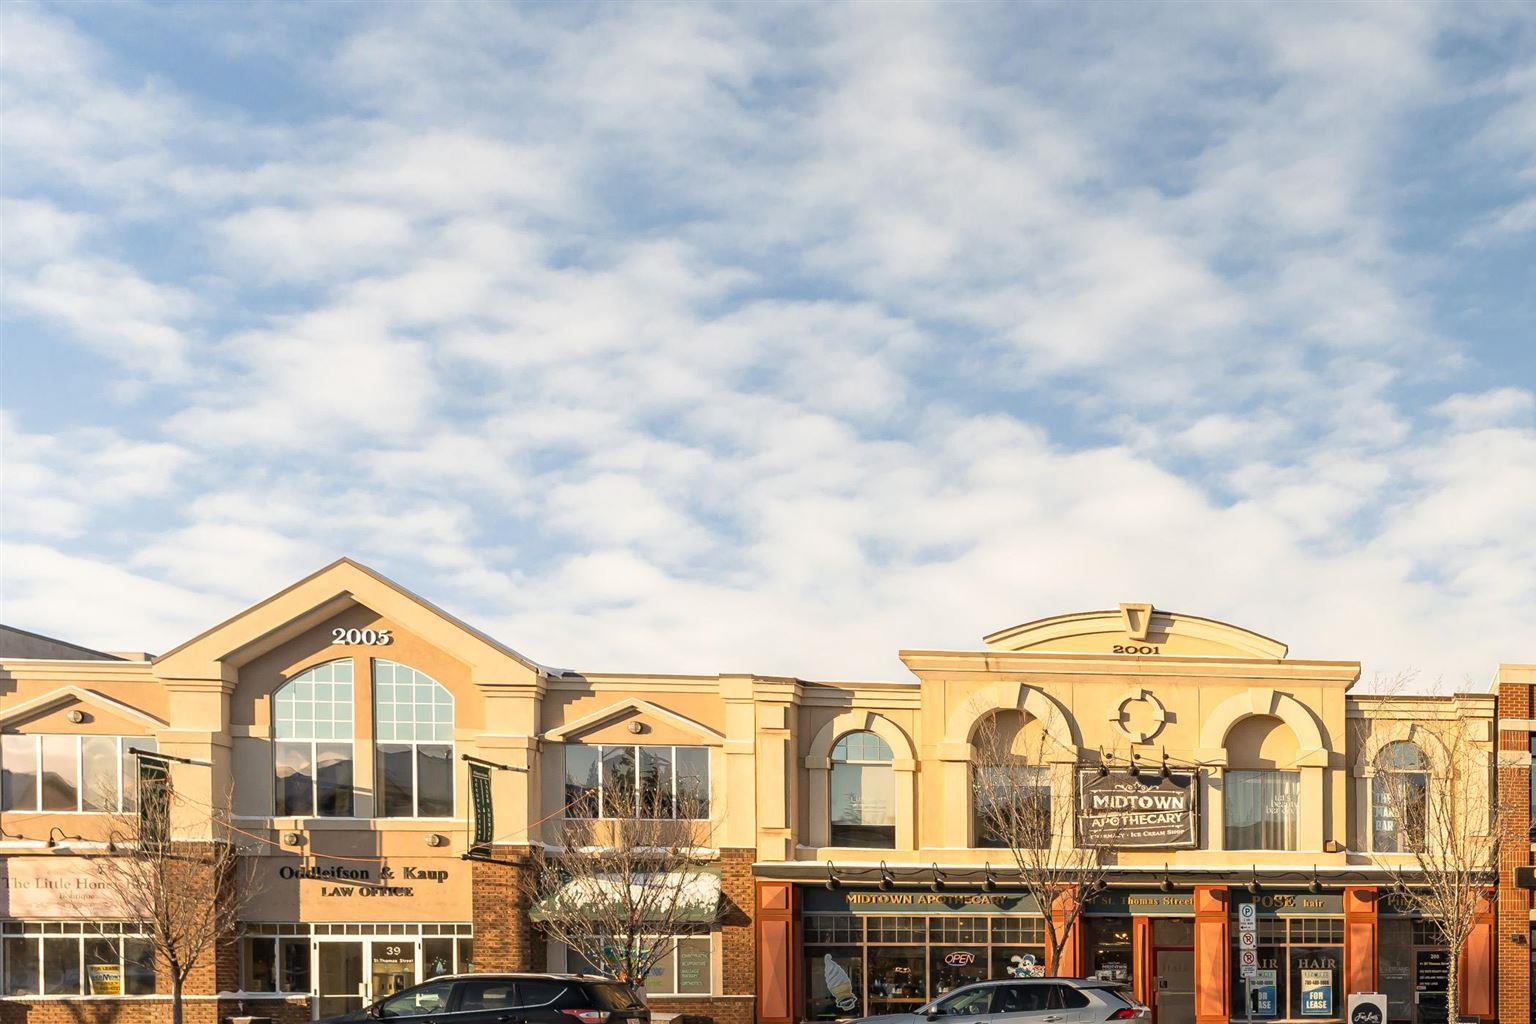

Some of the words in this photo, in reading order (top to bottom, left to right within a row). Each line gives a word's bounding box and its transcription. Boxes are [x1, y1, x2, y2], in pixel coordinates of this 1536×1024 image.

[332, 628, 391, 645] 2005
[1113, 645, 1160, 655] 2001
[1093, 795, 1184, 809] MIDTOWN
[1376, 820, 1393, 830] BAR
[279, 866, 369, 880] Oddleifson
[381, 865, 395, 880] &
[403, 867, 448, 883] Kaup
[3, 877, 30, 889] The
[36, 877, 71, 889] Little
[321, 887, 354, 896] LAW
[359, 887, 414, 896] OFFICE
[846, 894, 912, 904] MIDTOWN
[918, 894, 1008, 904] APOTHECARY
[1163, 897, 1194, 905] Street
[1253, 895, 1296, 907] POSE
[1303, 899, 1324, 907] hair
[386, 946, 401, 955] 39
[945, 954, 975, 964] OPEN
[1257, 959, 1278, 968] AIR
[1298, 959, 1336, 968] HAIR
